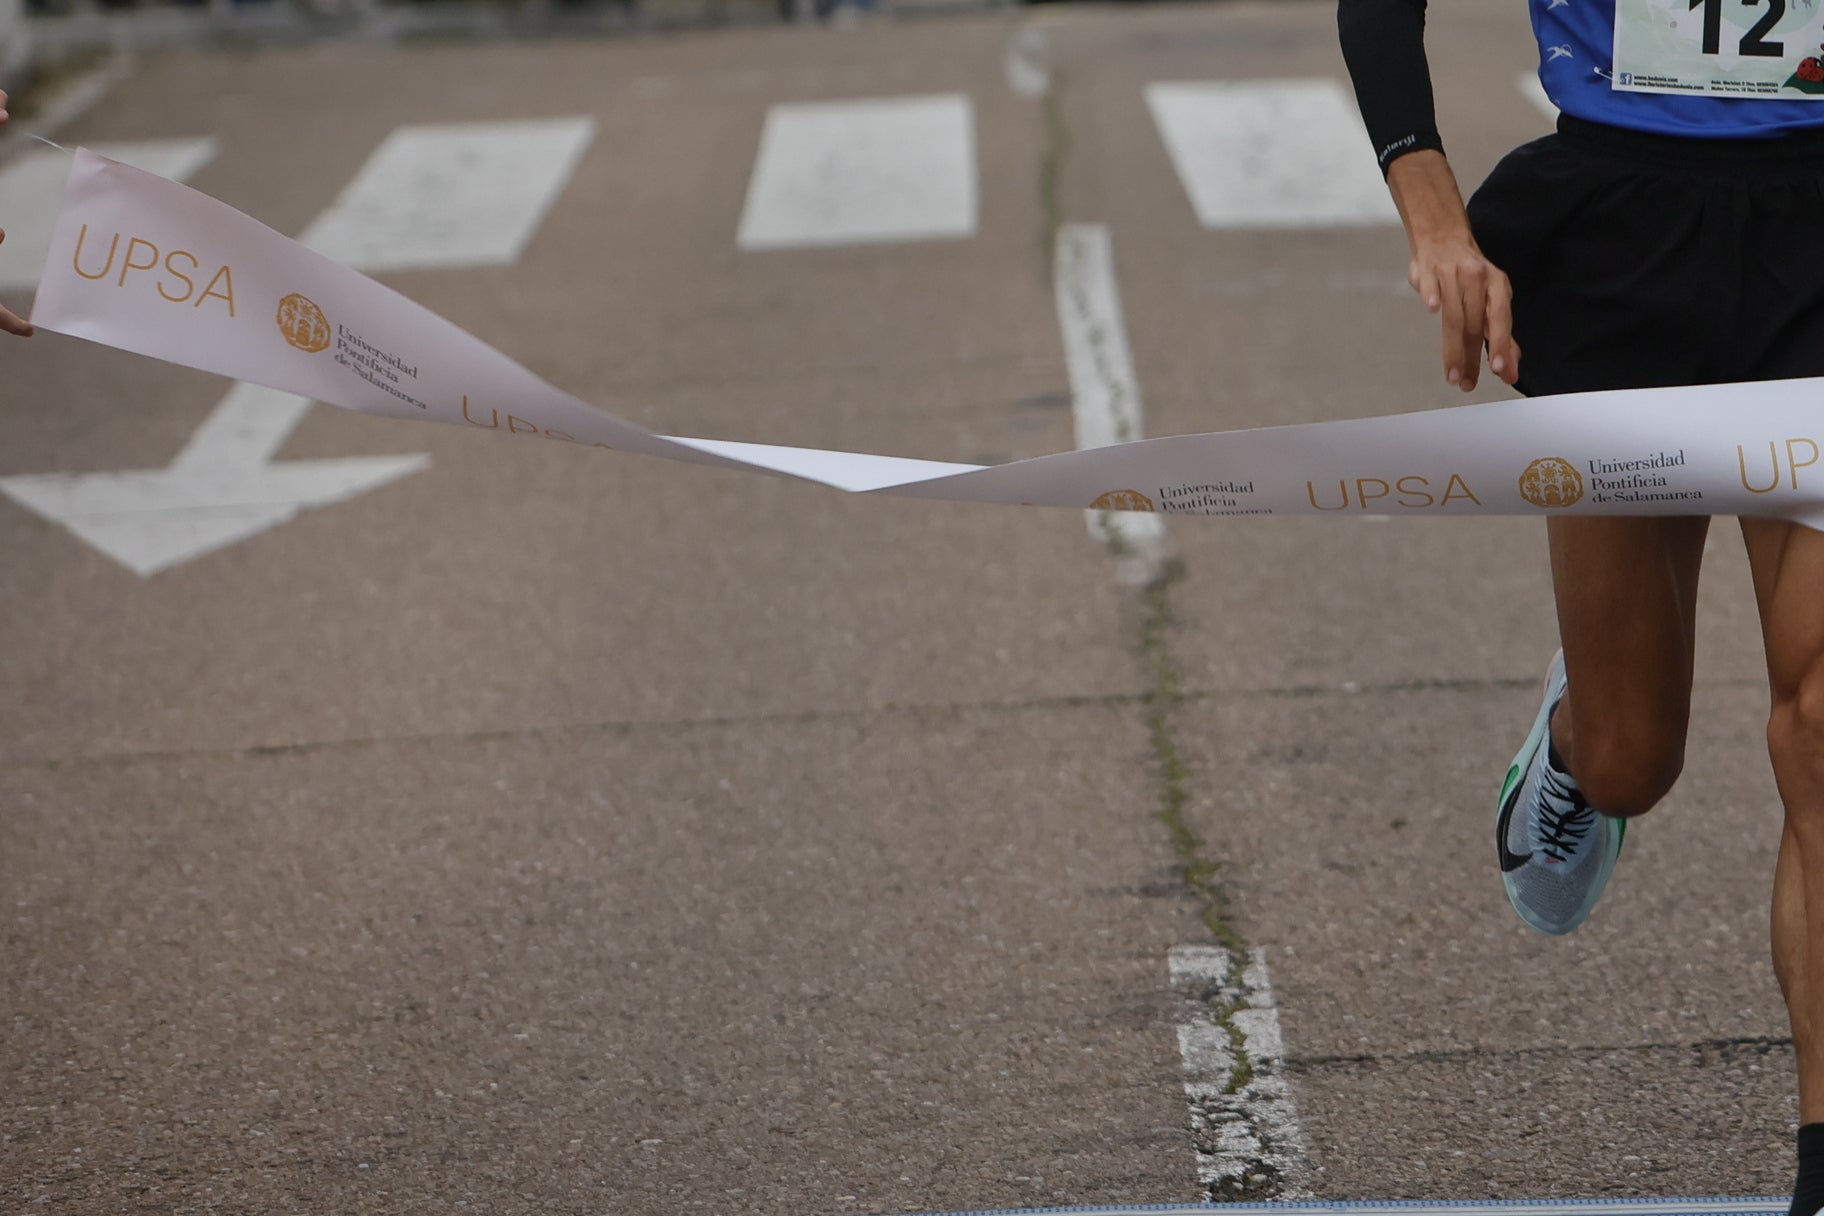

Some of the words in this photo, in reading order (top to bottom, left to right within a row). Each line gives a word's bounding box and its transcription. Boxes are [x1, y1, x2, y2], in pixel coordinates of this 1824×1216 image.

[72, 223, 236, 317] UPSA
[336, 338, 400, 384] Pontificia
[337, 324, 418, 379] Universidad
[334, 353, 352, 368] de
[352, 362, 428, 410] Salamanca
[1588, 449, 1685, 474] Universidad
[1159, 482, 1254, 499] Universidad
[1306, 473, 1482, 511] UPSA
[1591, 473, 1667, 490] Pontificia
[1592, 493, 1612, 503] de
[1614, 490, 1704, 502] Salamanca
[1161, 495, 1237, 510] Pontificia
